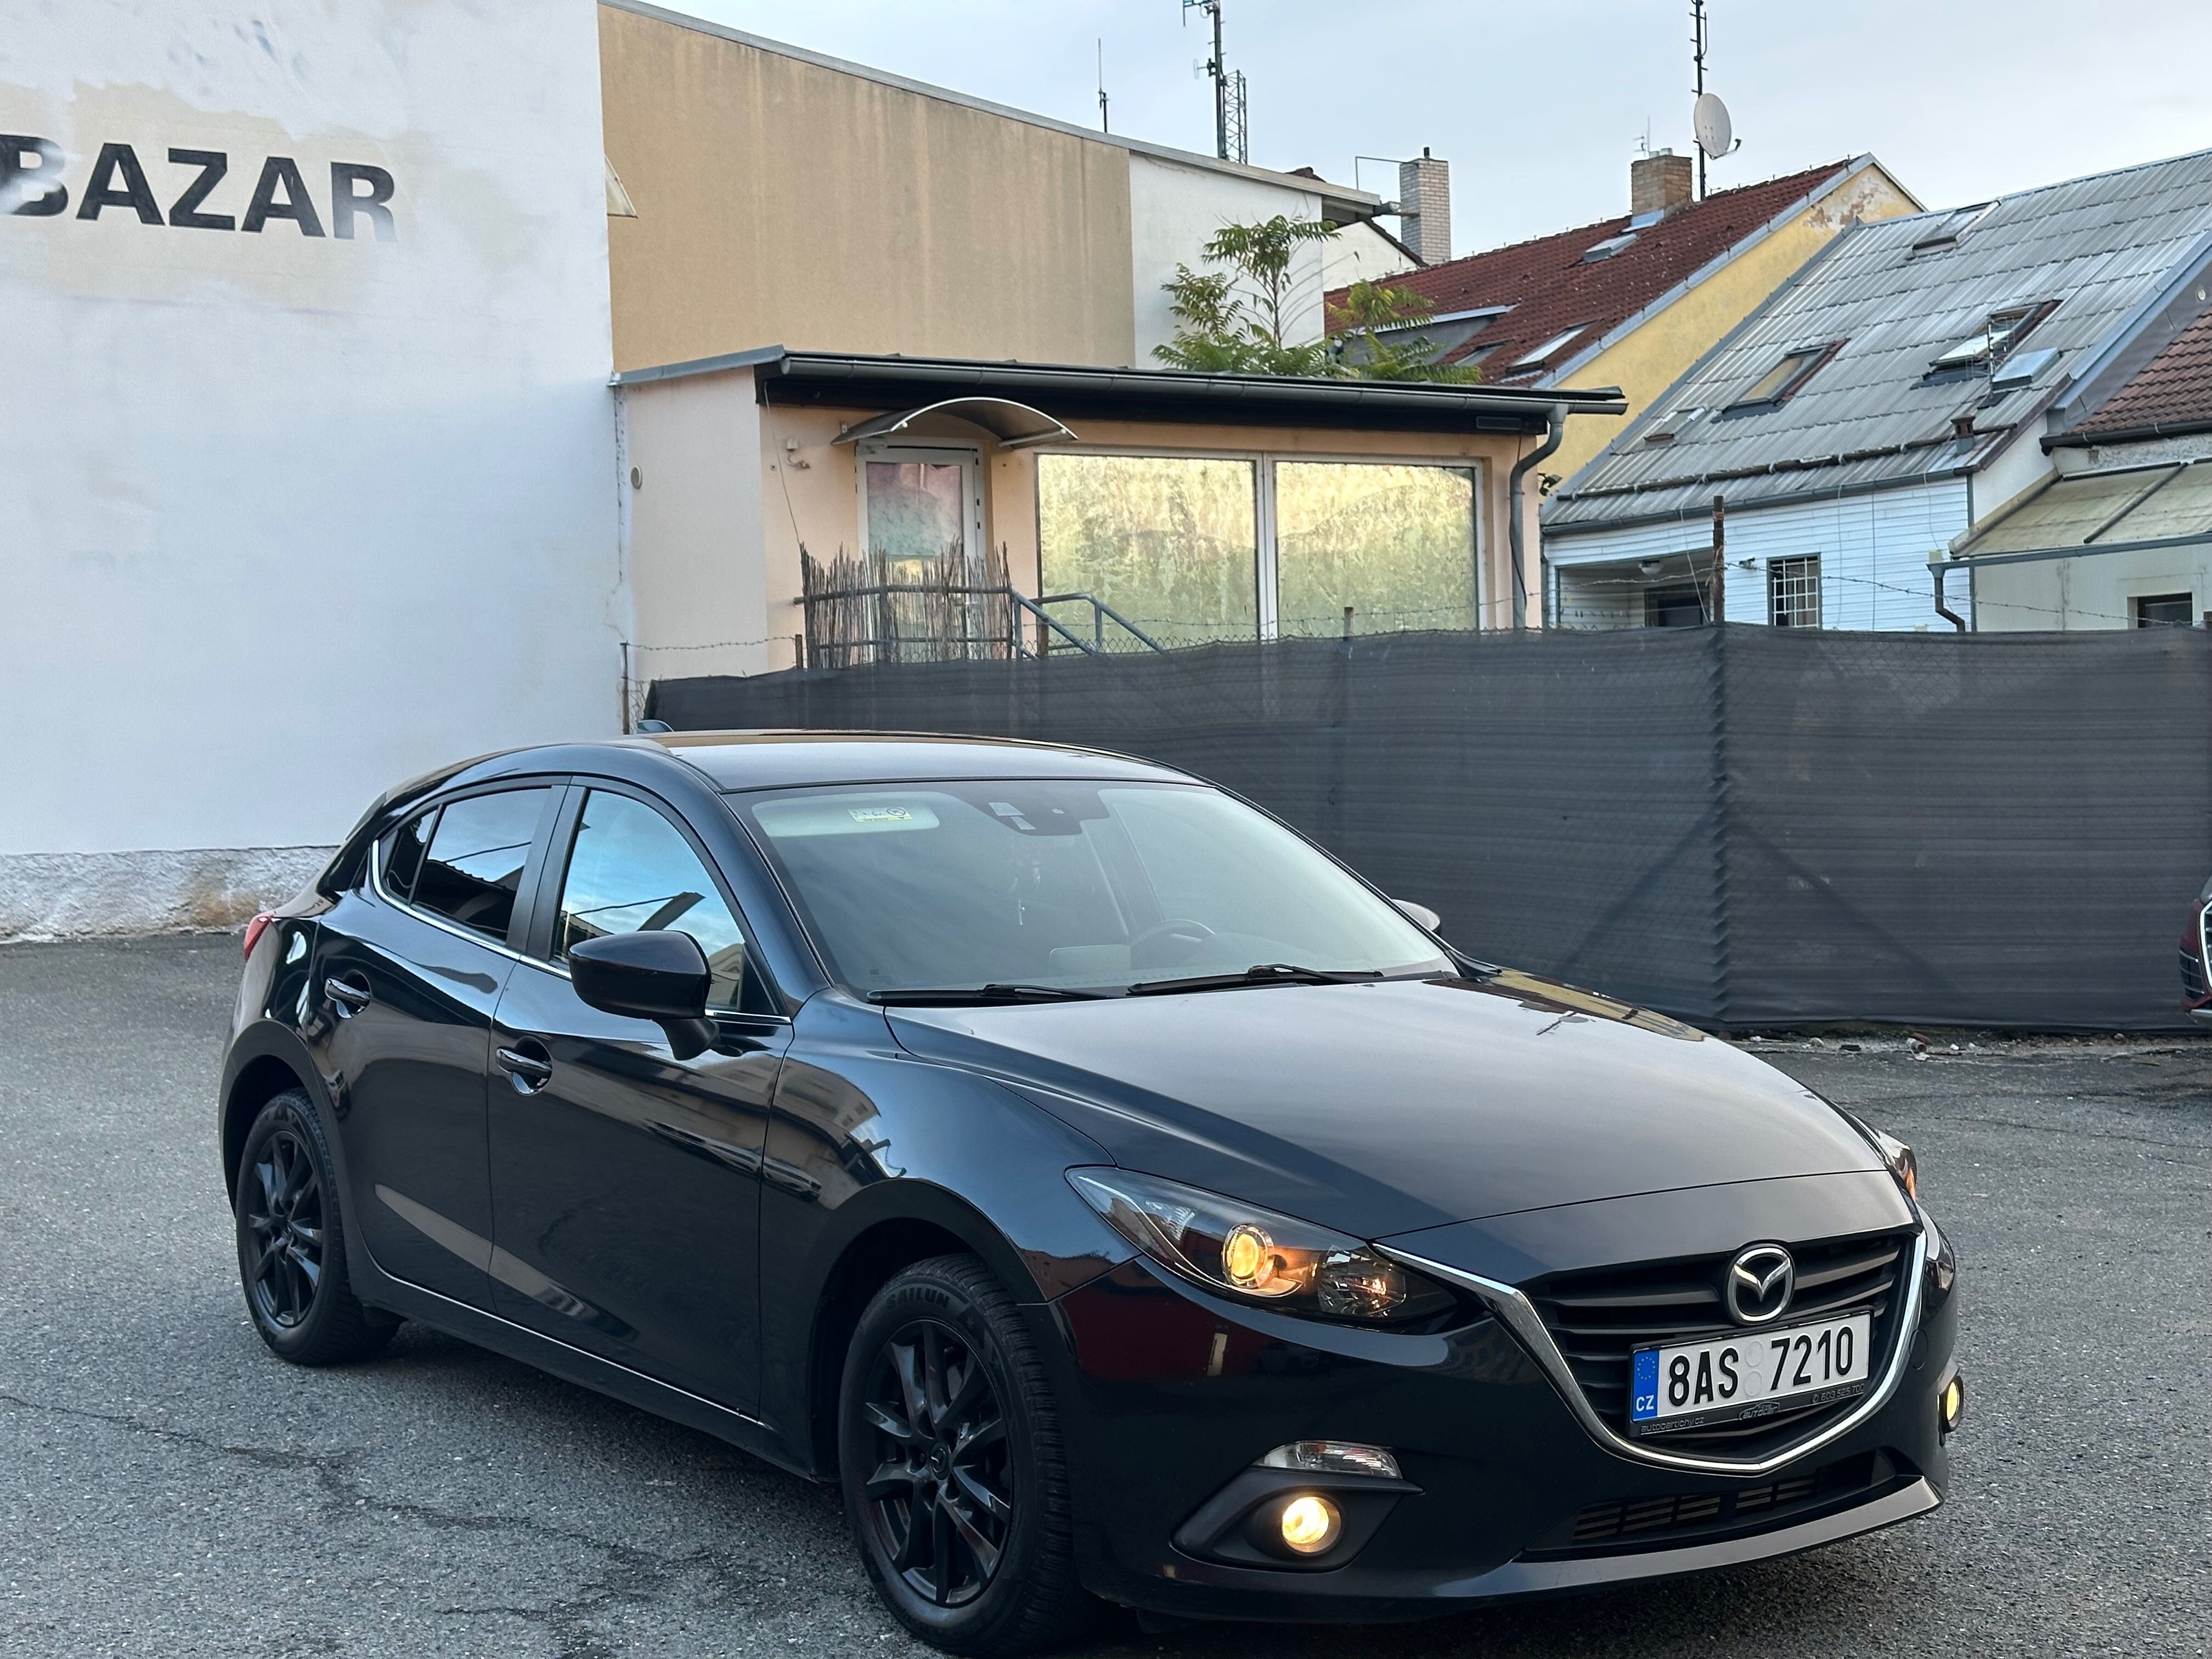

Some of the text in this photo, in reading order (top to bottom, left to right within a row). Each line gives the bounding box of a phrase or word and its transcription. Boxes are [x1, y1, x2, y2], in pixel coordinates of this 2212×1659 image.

[0, 133, 397, 242] BAZAR
[886, 1286, 950, 1309] SAILUN
[1668, 1326, 1854, 1407] 8AS 7210
[1636, 1395, 1654, 1412] CZ
